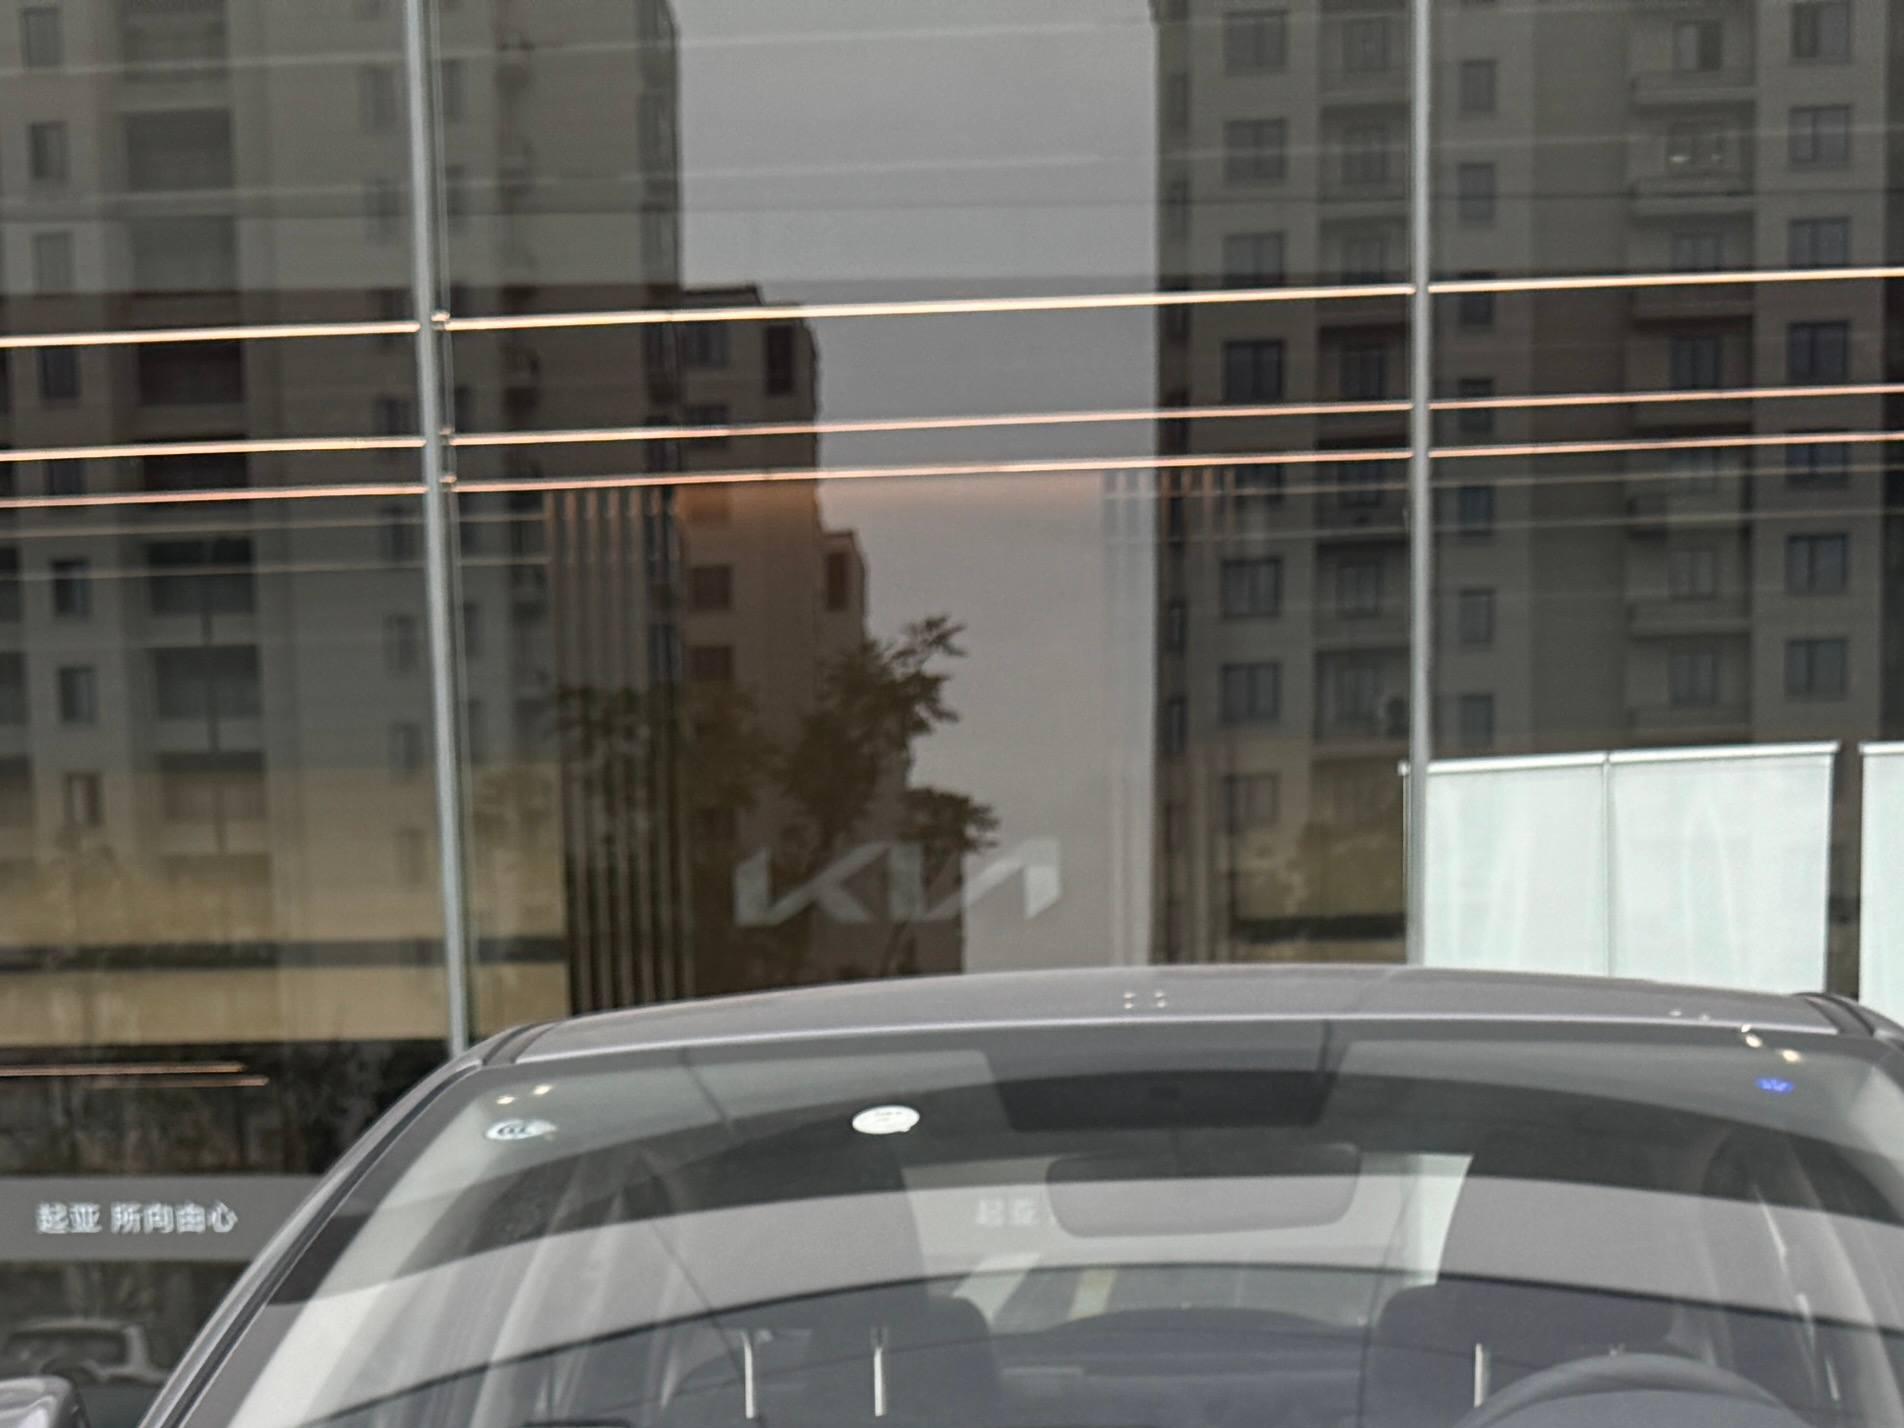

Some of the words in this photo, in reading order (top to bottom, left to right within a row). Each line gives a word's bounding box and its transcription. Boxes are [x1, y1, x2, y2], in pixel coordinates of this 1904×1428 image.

[734, 838, 1061, 928] KIA
[36, 1202, 101, 1235] 起亚
[110, 1201, 239, 1234] 所向由心
